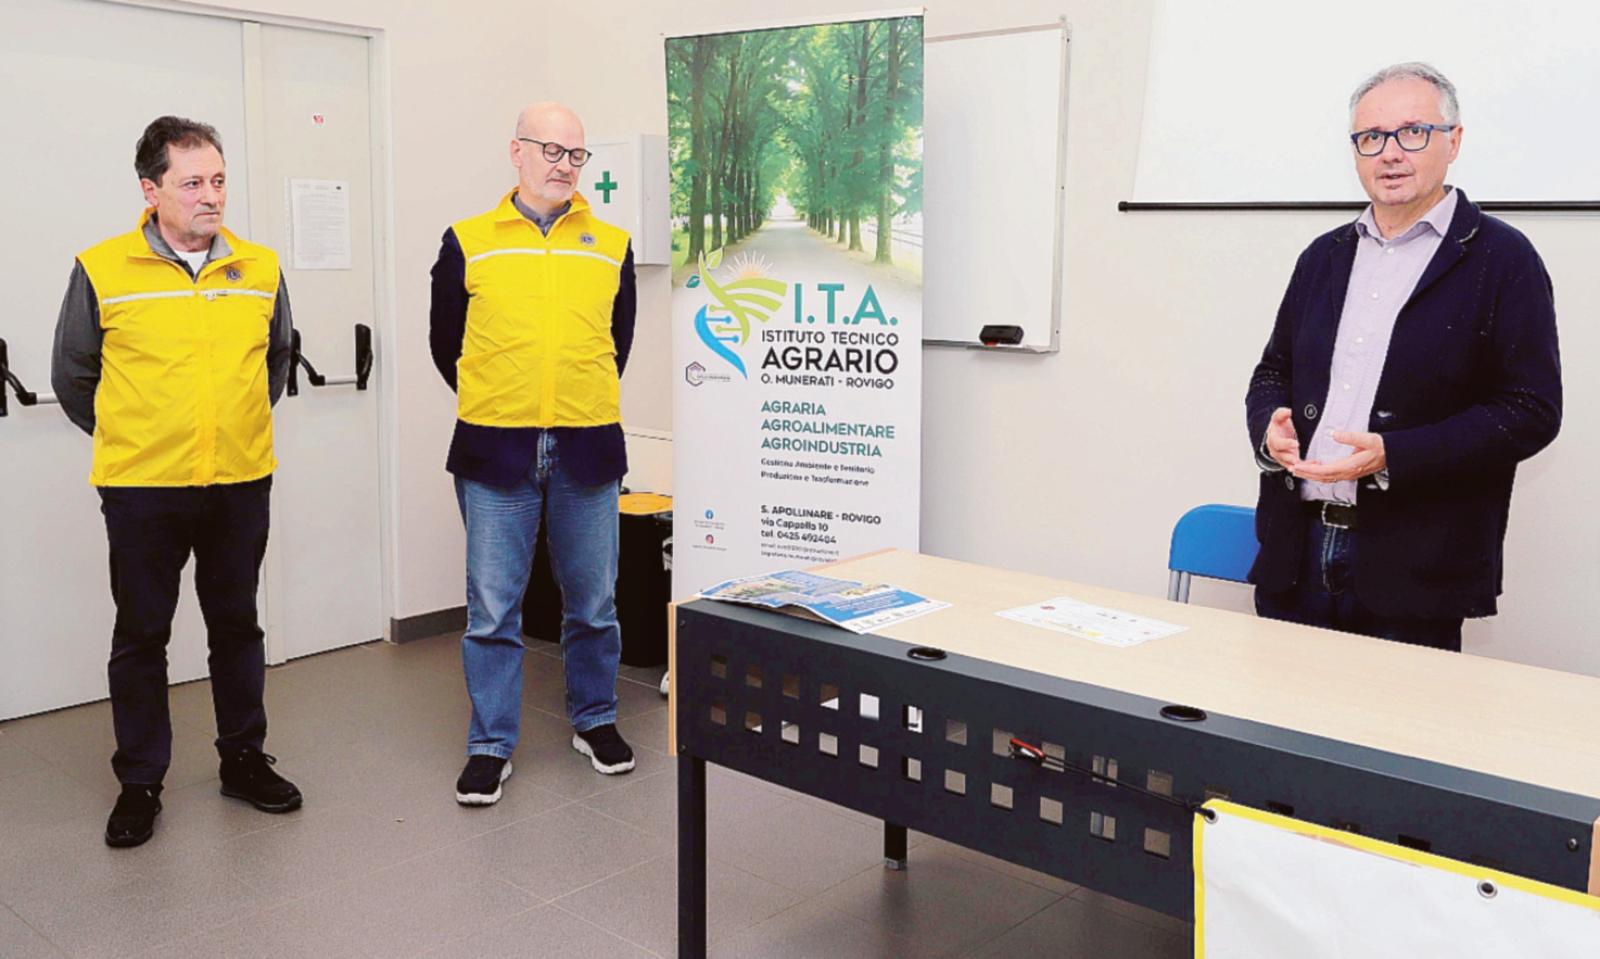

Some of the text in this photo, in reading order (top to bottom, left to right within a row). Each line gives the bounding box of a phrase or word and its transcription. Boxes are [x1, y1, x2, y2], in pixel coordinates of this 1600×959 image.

[794, 283, 898, 325] I.T.A.
[761, 329, 899, 347] ISTITUTO TECNICO
[761, 347, 899, 374] AGRARIO
[761, 374, 773, 384] O.
[776, 375, 834, 387] MUNERATI
[846, 378, 894, 390] ROVIGO
[761, 400, 826, 416] AGRARIA
[761, 418, 895, 439] AGROALIMENTARE
[761, 437, 882, 457] AGROINDUSTRIA
[761, 471, 803, 481] Produzione
[761, 504, 769, 513] S.
[772, 506, 833, 520] APOLLINARE
[842, 513, 881, 524] ROVIGO
[761, 517, 774, 527] via
[818, 522, 828, 532] 10
[777, 531, 800, 541] 0425
[802, 533, 836, 544] 492404
